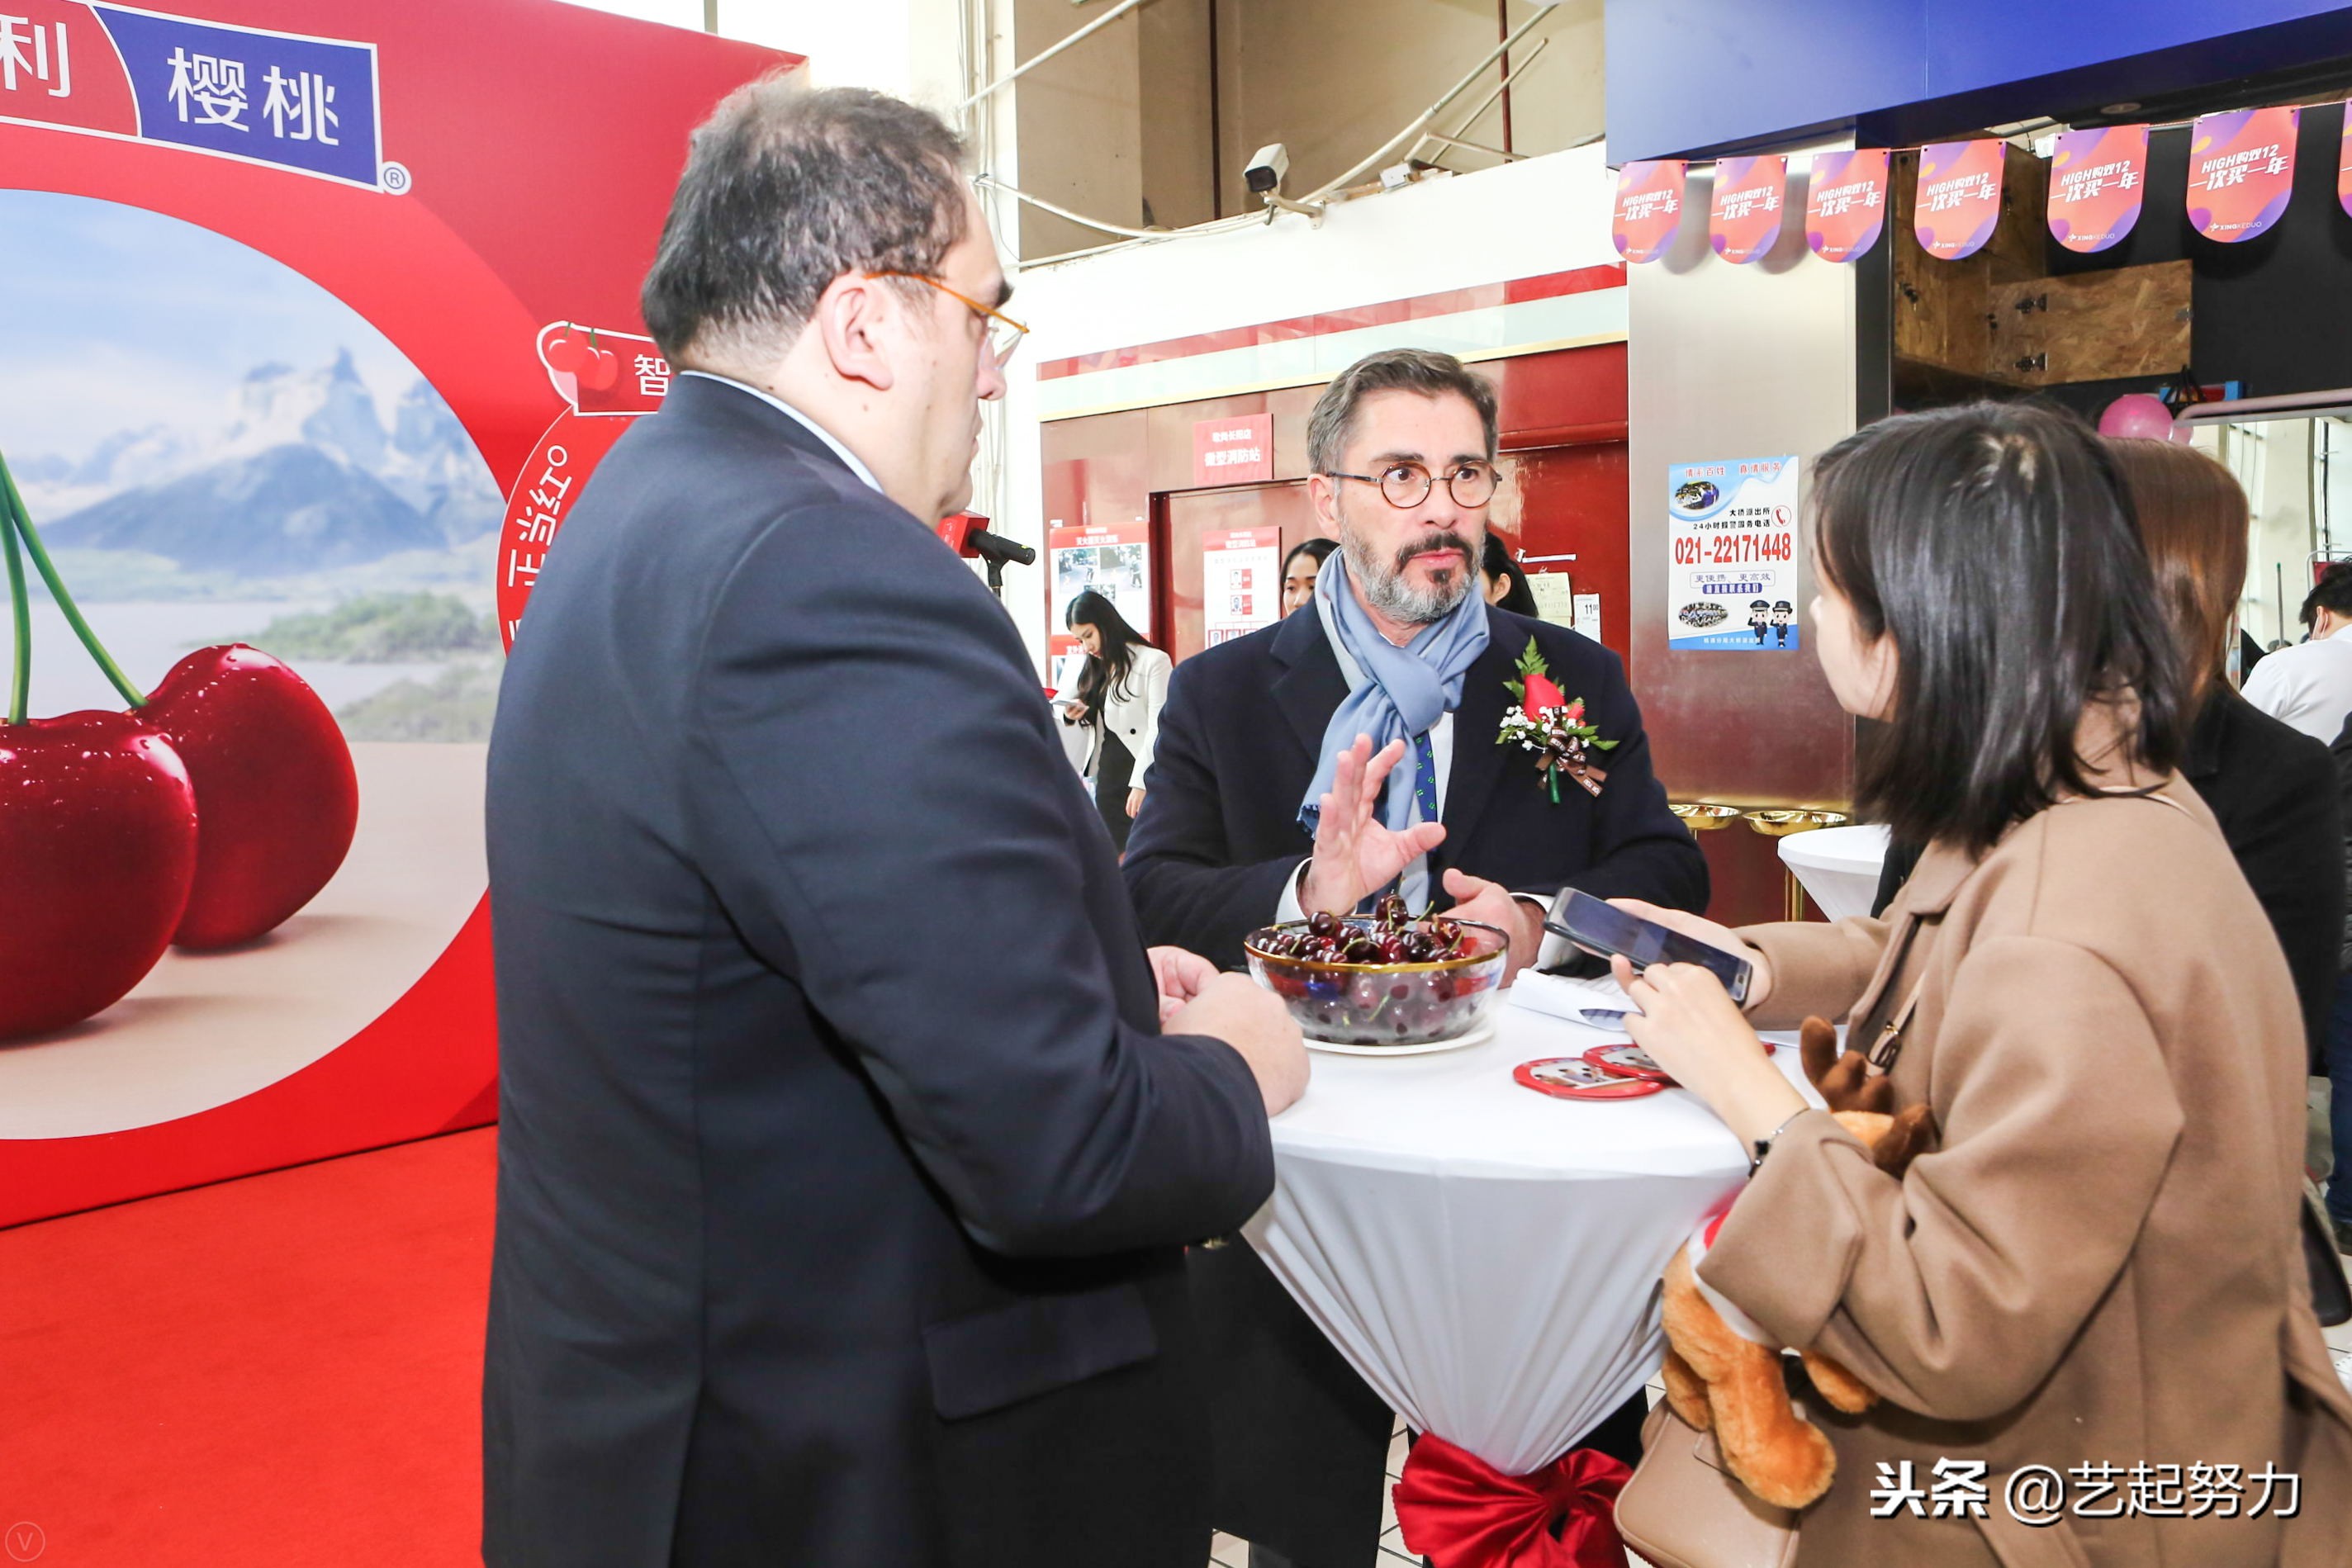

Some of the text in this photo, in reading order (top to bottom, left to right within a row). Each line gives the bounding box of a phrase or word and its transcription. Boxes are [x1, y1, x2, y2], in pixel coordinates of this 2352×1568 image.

[167, 47, 339, 146] 樱桃
[2051, 172, 2139, 203] 一次买一年
[2189, 156, 2289, 192] 一次买一年
[1675, 533, 1791, 565] 021-22171448
